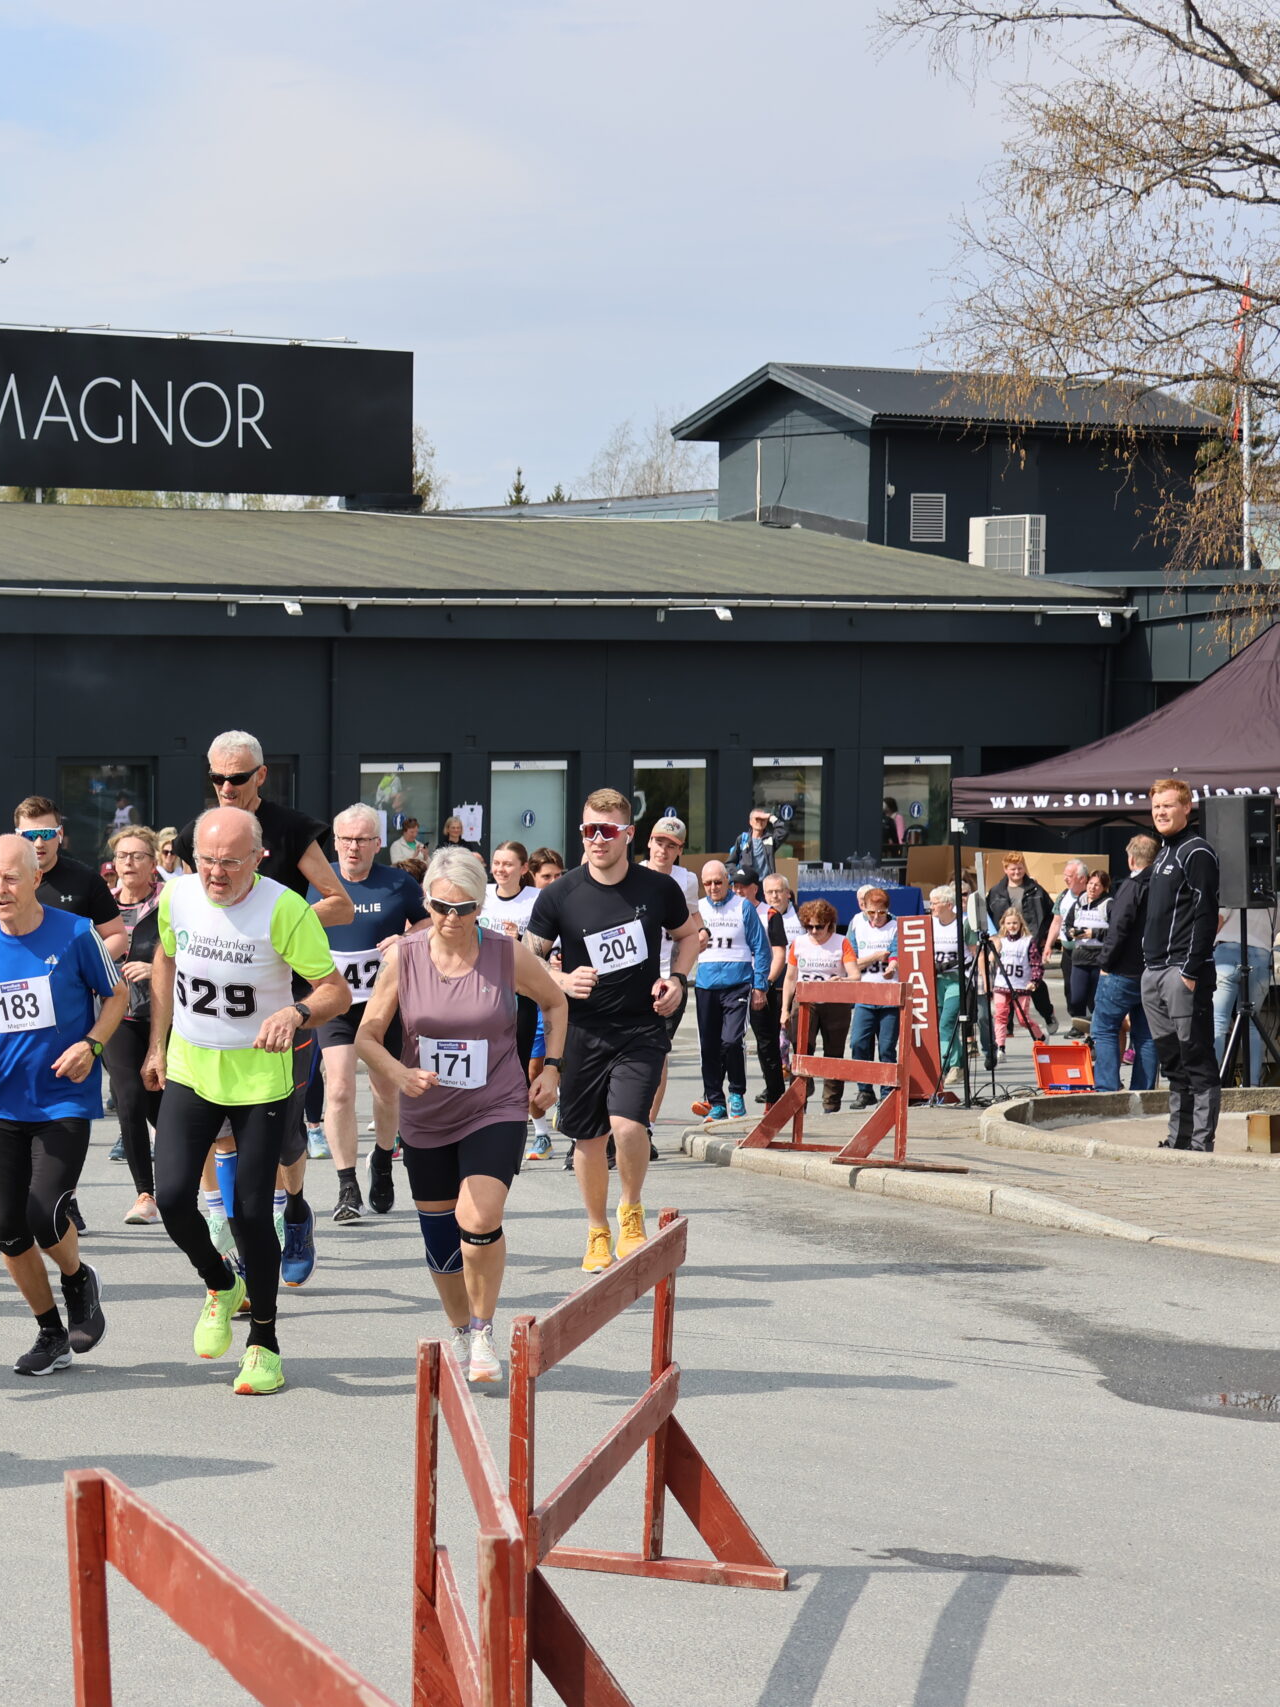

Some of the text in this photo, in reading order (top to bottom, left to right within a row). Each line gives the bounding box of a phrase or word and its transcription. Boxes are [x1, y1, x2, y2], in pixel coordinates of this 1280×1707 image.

[187, 943, 254, 964] HEDMARK
[191, 930, 256, 952] Sparebanken
[599, 935, 638, 964] 204
[903, 919, 929, 1048] START
[430, 1052, 471, 1078] 171
